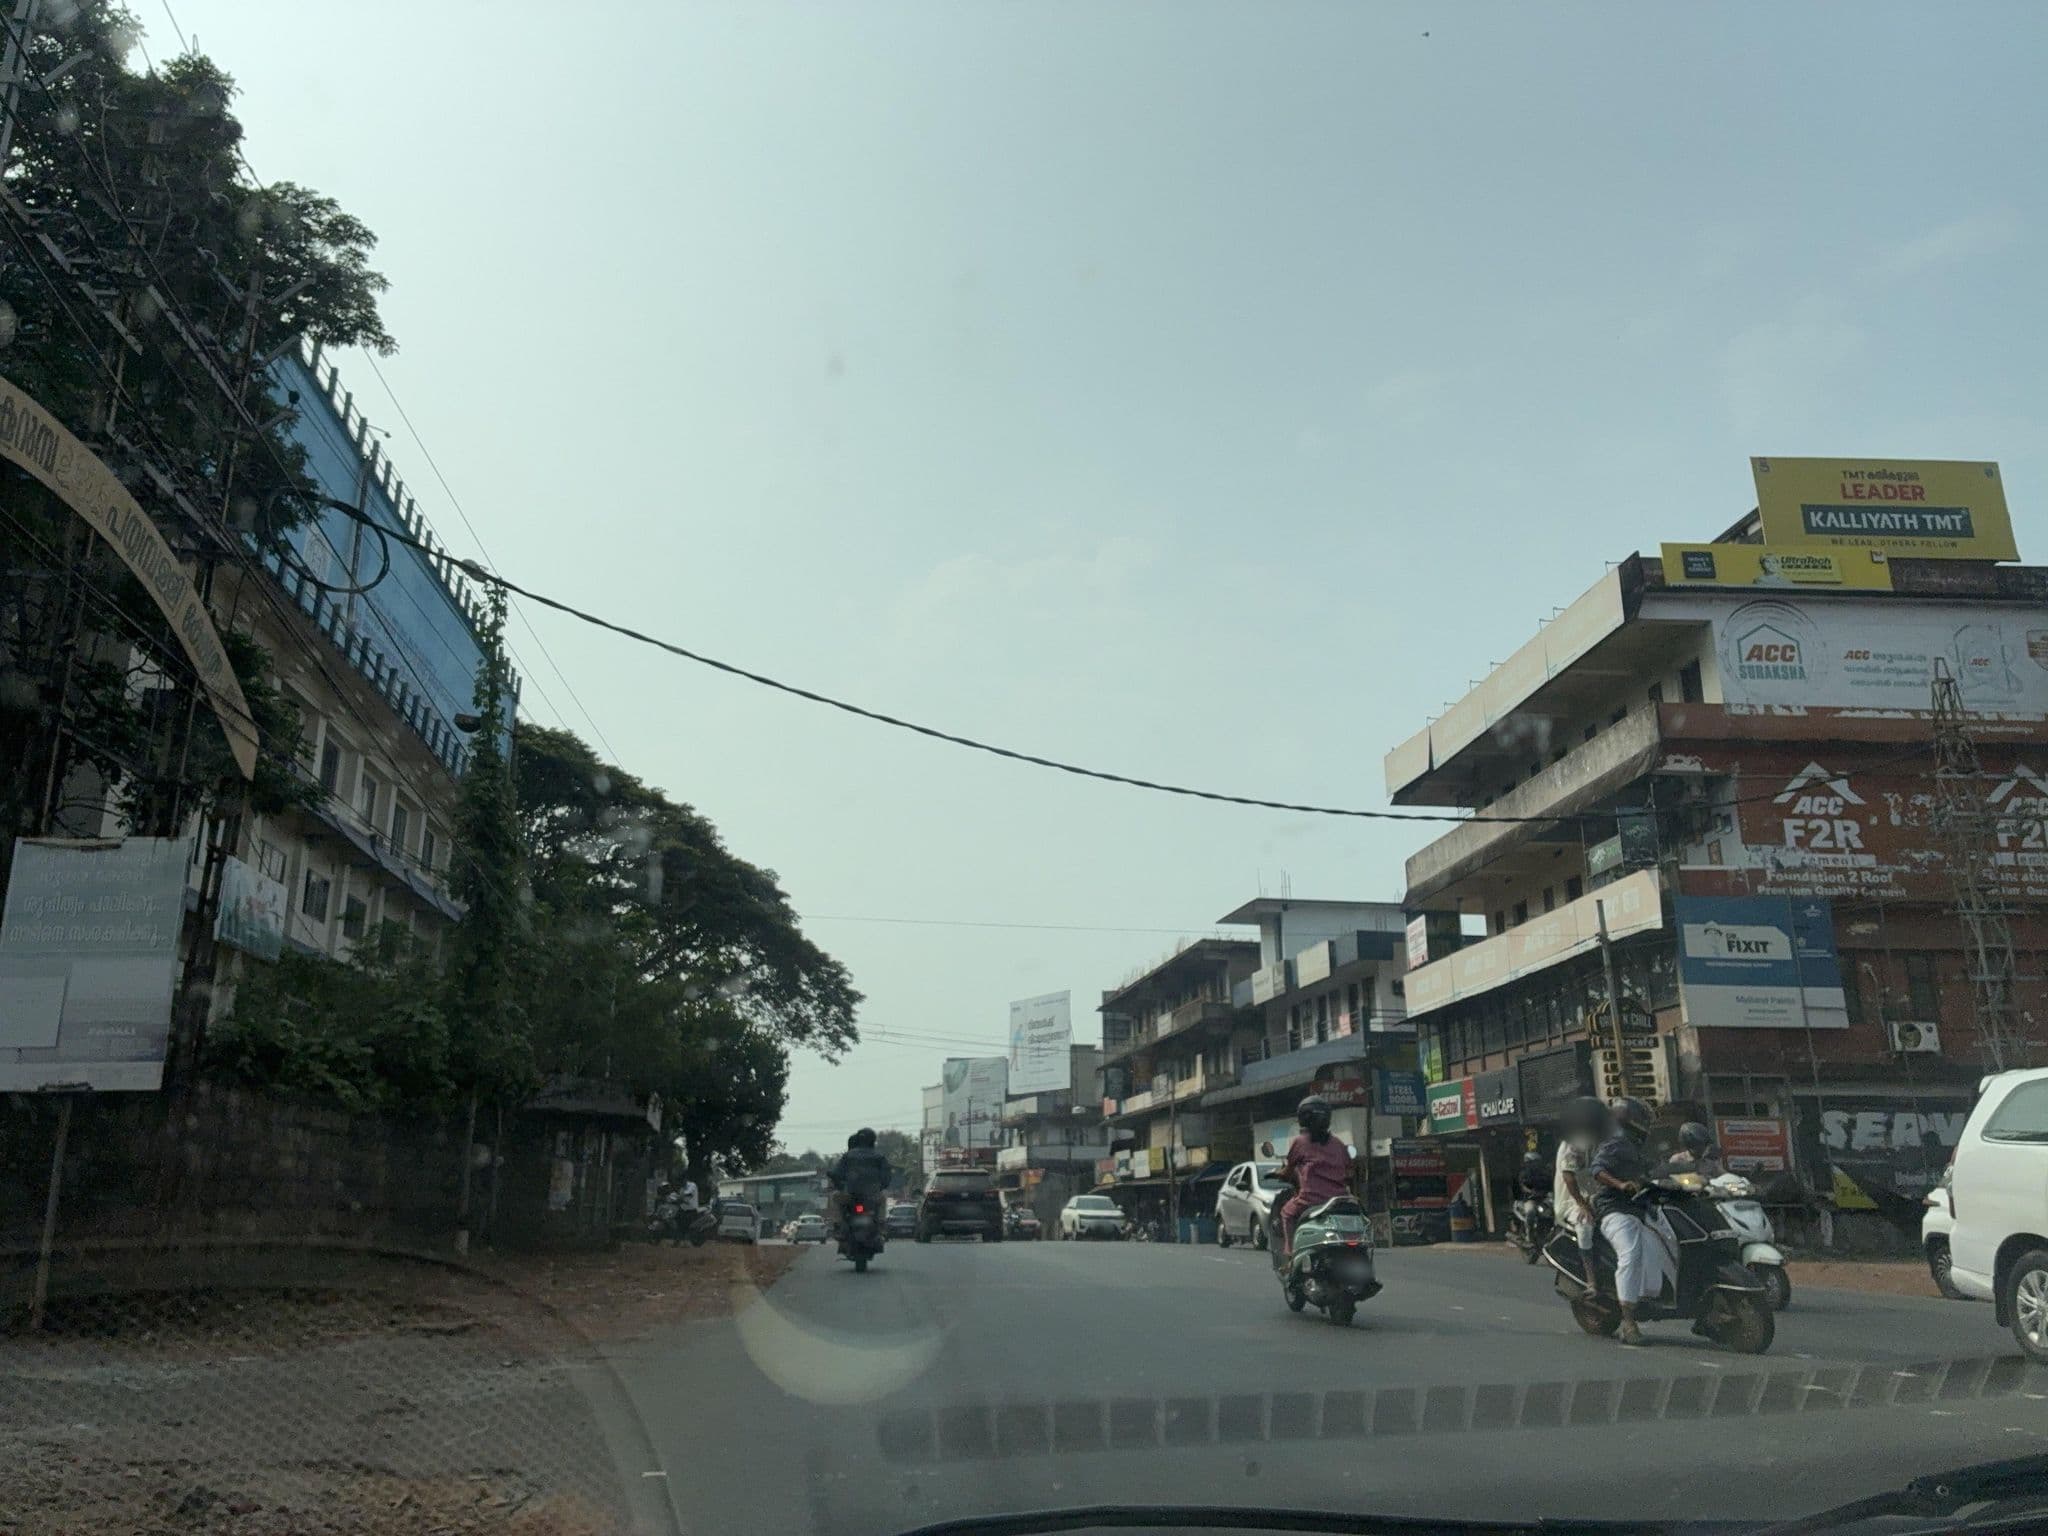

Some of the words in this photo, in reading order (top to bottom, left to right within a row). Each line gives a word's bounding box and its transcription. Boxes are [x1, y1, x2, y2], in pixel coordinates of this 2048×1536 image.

[1841, 470, 1865, 481] TMT
[1840, 483, 1926, 501] LEADER
[1809, 511, 1919, 531] KALLIYATH
[1924, 514, 1963, 531] TMT
[1781, 556, 1831, 565] UltraTech
[1745, 644, 1796, 663] ACC
[1843, 650, 1871, 661] ACC
[1738, 664, 1806, 681] SURAKSHA
[1792, 796, 1844, 816] ACC
[1783, 818, 1865, 849] F2R
[1766, 870, 1845, 884] Foundation
[1847, 871, 1859, 884] 2
[1861, 871, 1894, 884] Roof
[1727, 940, 1769, 954] FIXIT
[1438, 1098, 1459, 1117] Castrol
